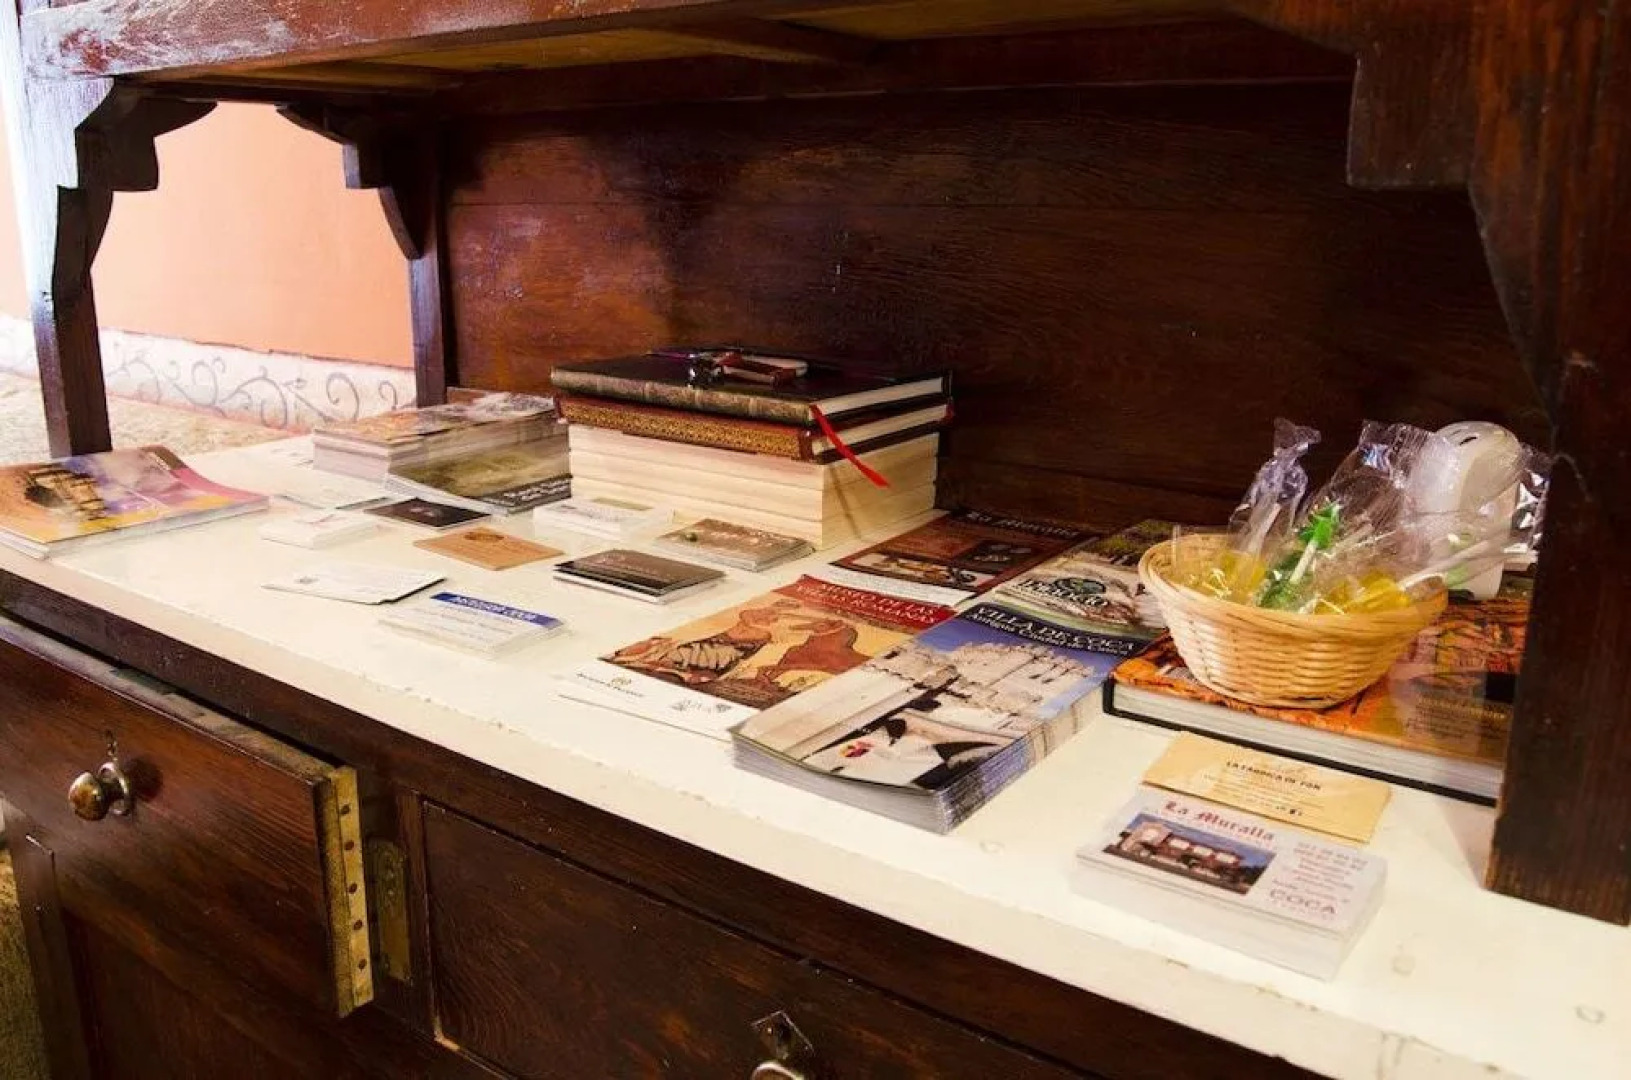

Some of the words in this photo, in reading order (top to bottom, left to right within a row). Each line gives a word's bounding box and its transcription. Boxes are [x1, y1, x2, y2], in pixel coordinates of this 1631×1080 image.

[849, 598, 936, 624] ROMANAS
[904, 603, 934, 616] LAS
[977, 606, 1034, 632] VILLA
[1038, 624, 1068, 642] DE
[1071, 633, 1136, 653] COCA
[1163, 800, 1188, 816] La
[1197, 809, 1275, 842] Muralla
[1268, 888, 1338, 915] COCA
